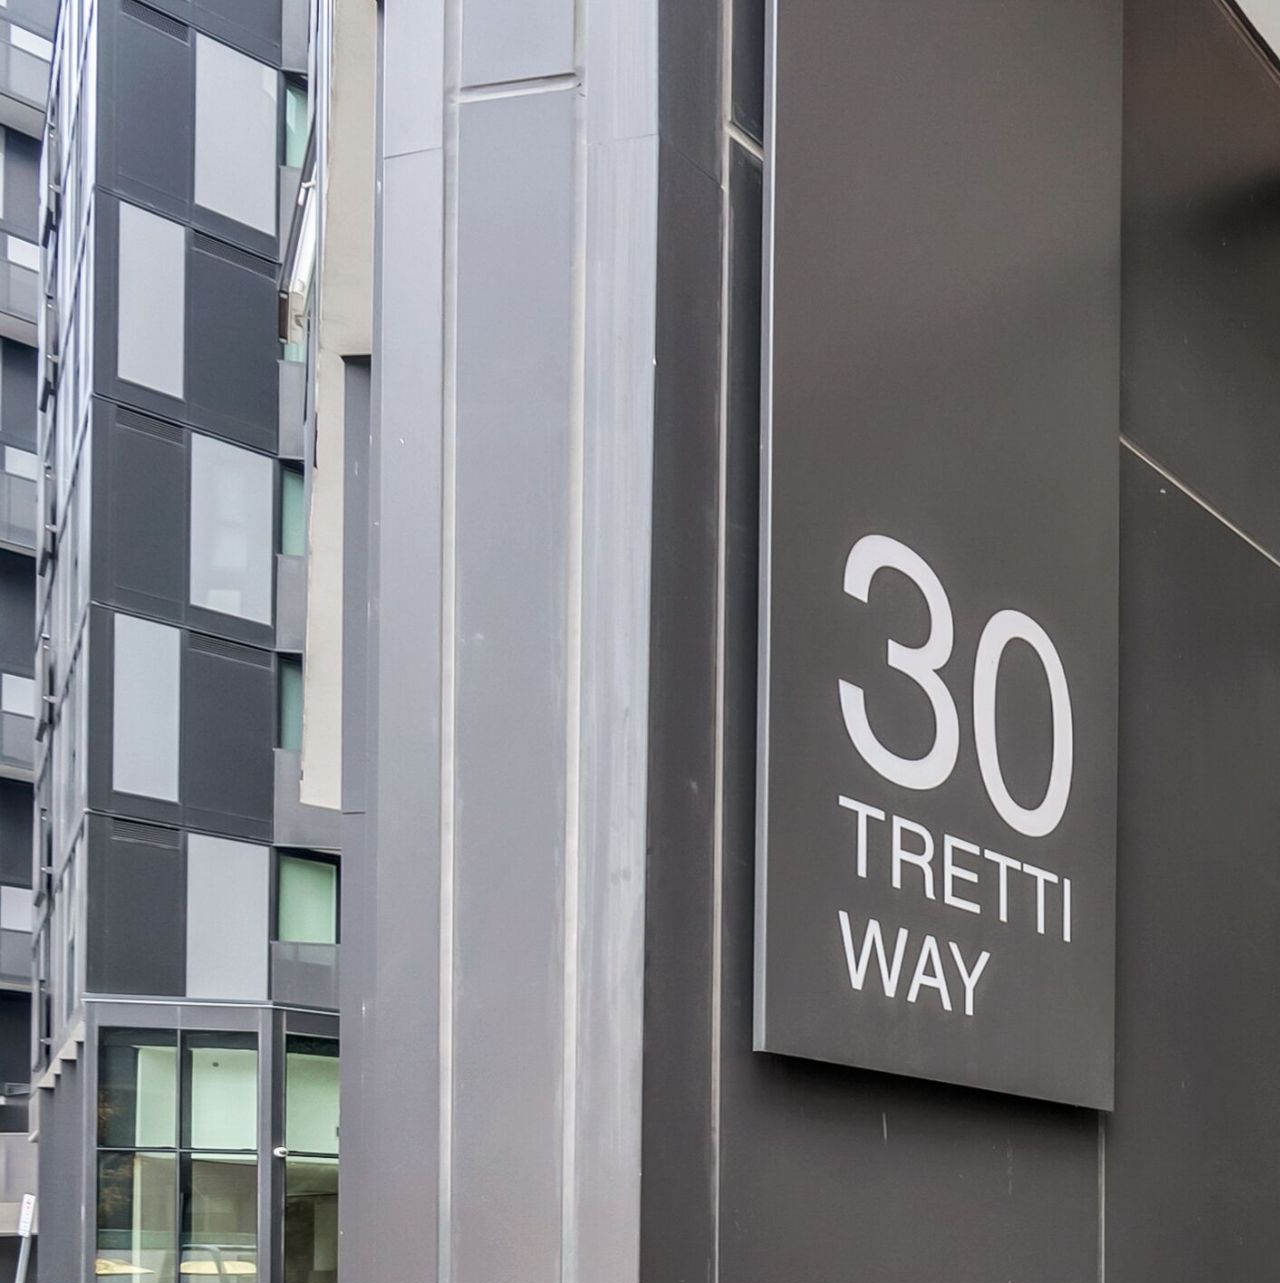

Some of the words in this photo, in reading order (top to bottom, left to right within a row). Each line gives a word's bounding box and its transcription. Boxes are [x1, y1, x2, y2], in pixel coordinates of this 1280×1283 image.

[838, 534, 1074, 838] 30
[838, 795, 1072, 943] TRETTI
[838, 910, 991, 1016] WAY
